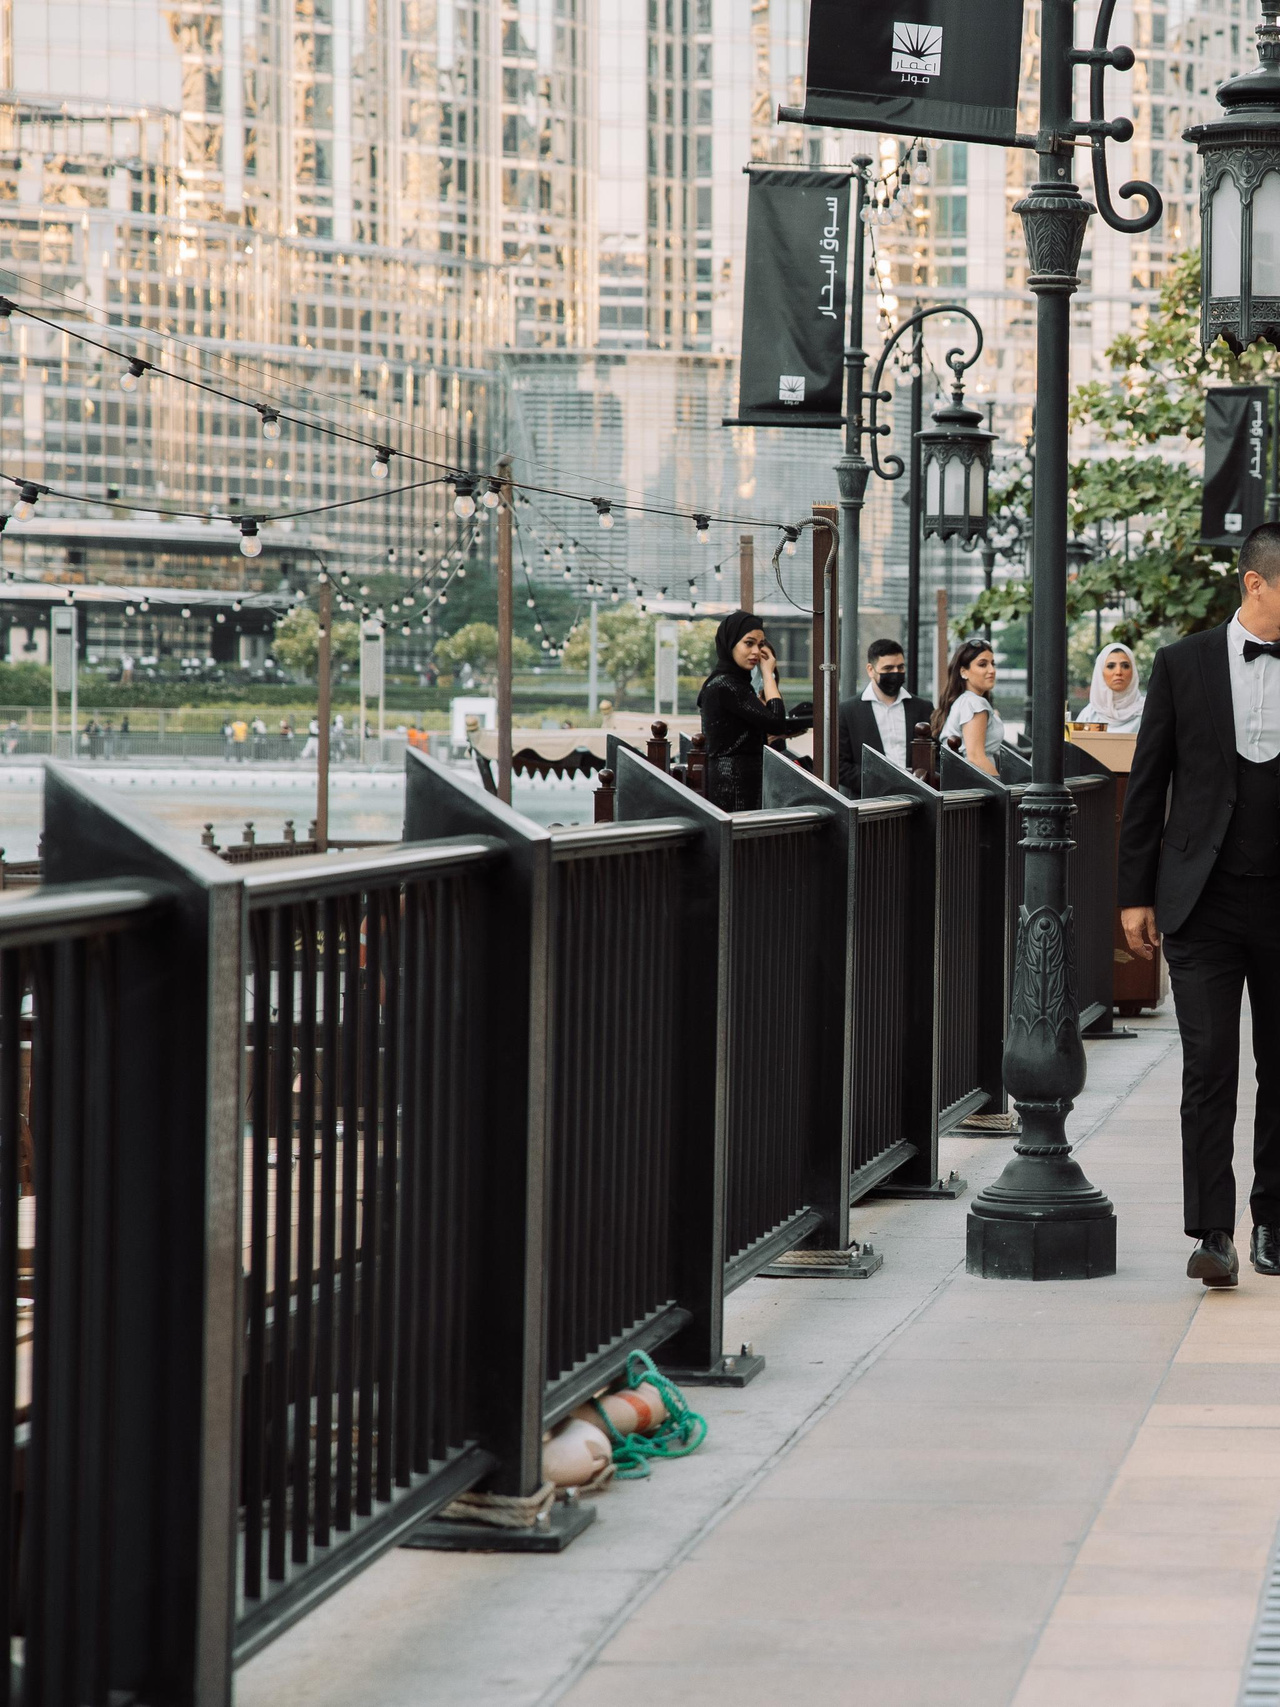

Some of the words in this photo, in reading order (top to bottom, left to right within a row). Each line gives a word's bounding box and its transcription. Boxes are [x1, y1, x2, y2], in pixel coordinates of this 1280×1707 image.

[819, 197, 840, 252] سوق
[817, 254, 838, 320] البحار
[1249, 401, 1263, 438] سوق
[1249, 438, 1263, 479] البحار
